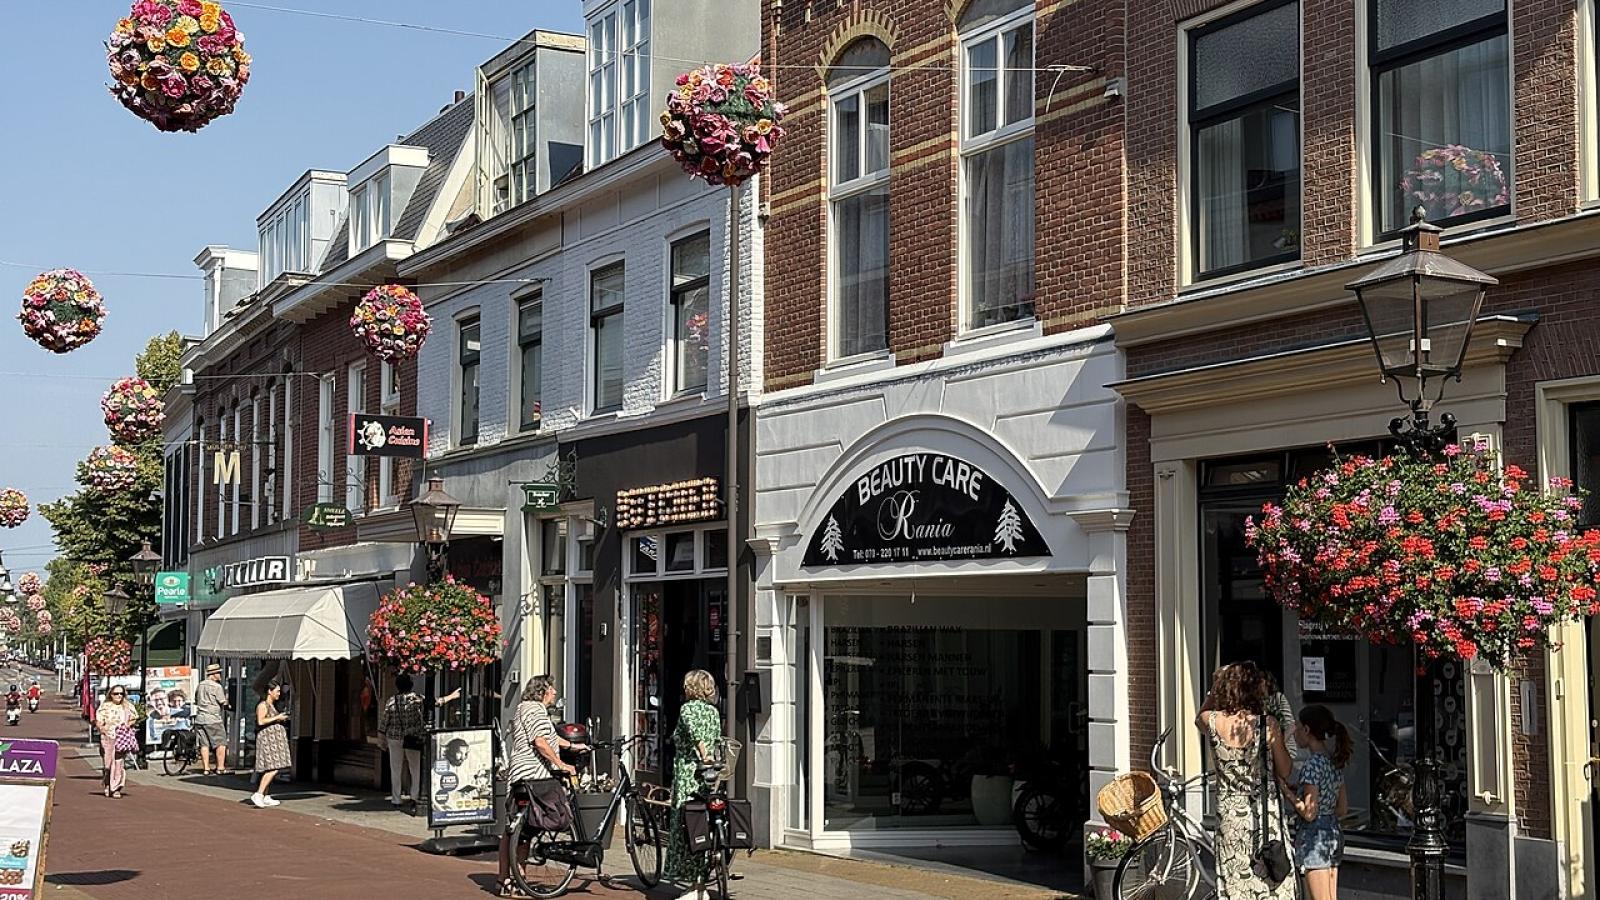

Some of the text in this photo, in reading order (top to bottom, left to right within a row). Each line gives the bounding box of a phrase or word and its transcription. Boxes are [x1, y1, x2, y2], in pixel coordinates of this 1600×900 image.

[389, 425, 415, 436] Asian
[213, 451, 241, 485] M
[858, 455, 983, 506] BEAUTY CARE
[877, 489, 955, 541] Rania
[917, 543, 992, 558] www.beautycarerania.nl
[157, 586, 186, 597] Pearle
